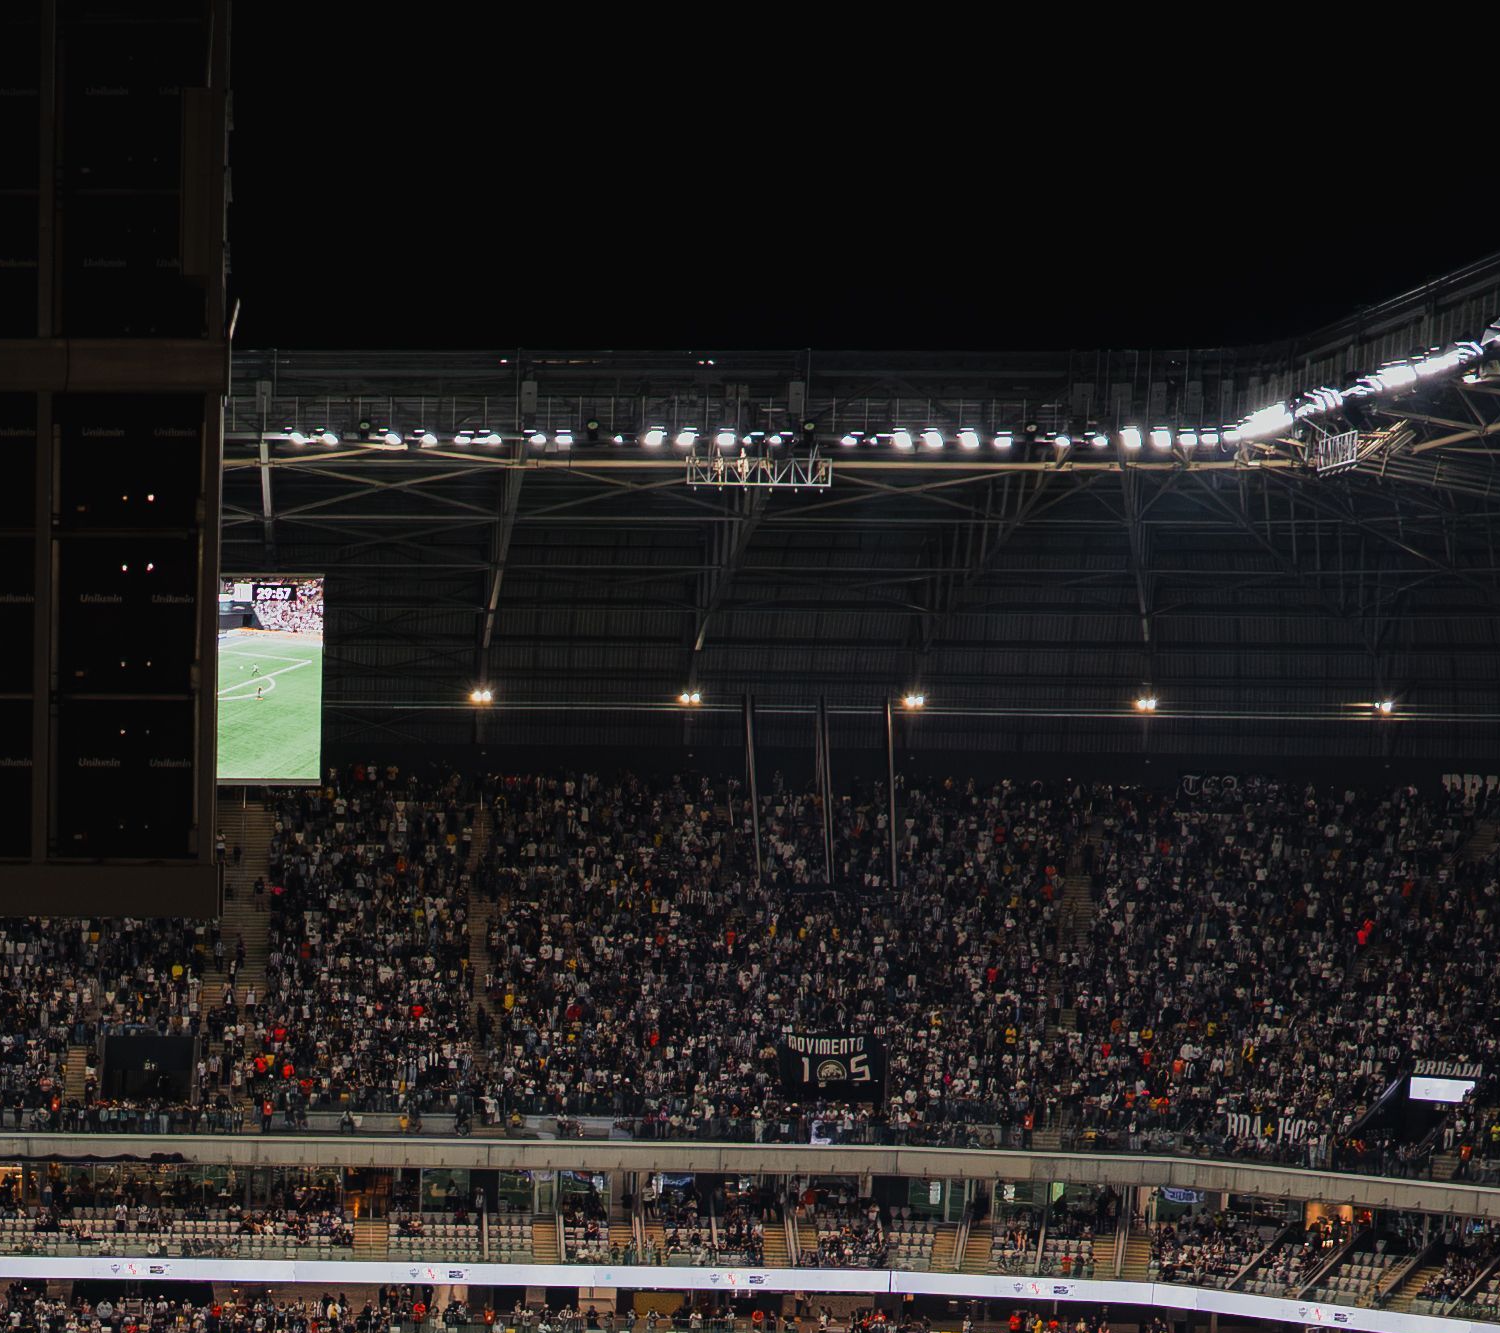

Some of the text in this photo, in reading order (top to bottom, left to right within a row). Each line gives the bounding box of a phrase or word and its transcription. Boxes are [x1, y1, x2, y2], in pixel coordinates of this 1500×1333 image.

[80, 593, 122, 603] Unilumin
[152, 593, 194, 604] Unilumin
[257, 588, 290, 600] 29:57
[79, 757, 120, 768] Unilumin
[150, 757, 191, 769] Unilumin
[788, 1037, 864, 1055] MOVIMENTO
